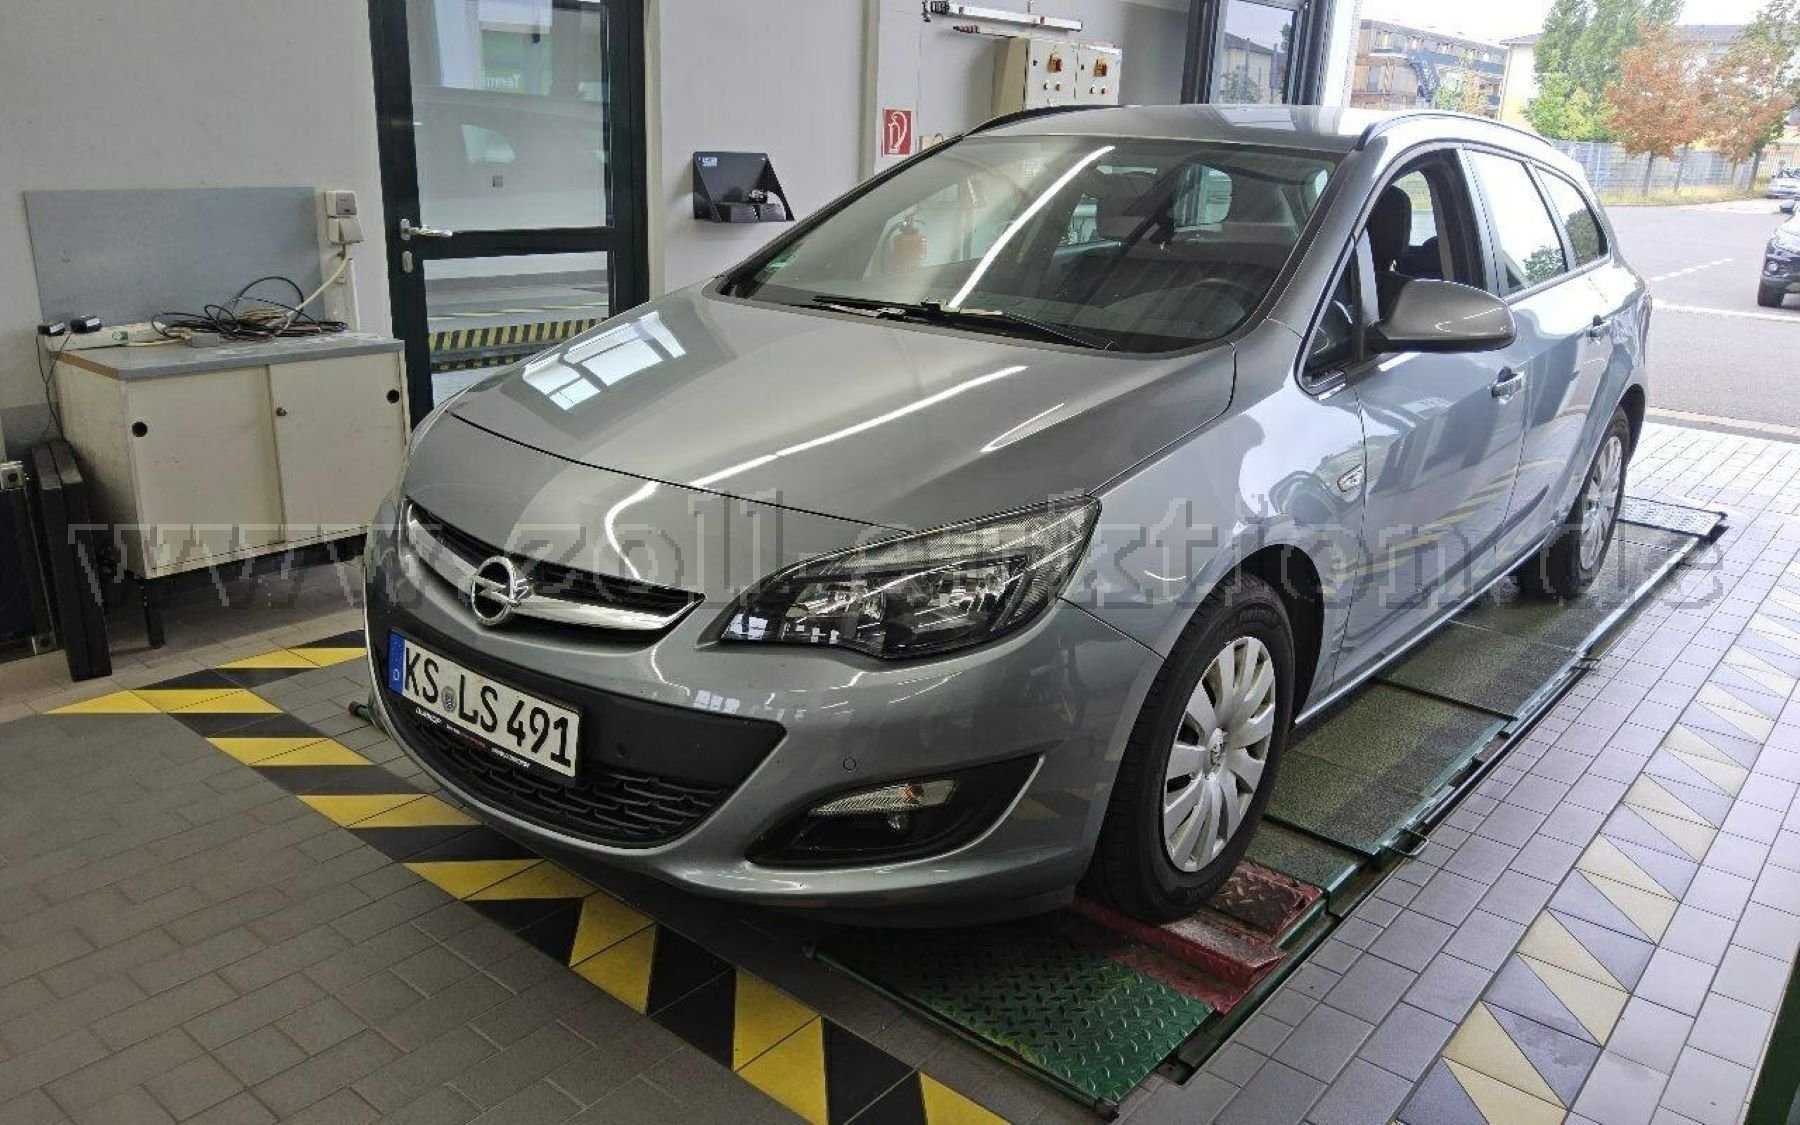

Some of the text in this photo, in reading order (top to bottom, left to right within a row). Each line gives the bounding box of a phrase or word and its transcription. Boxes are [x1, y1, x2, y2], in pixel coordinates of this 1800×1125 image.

[404, 647, 571, 768] KS LS 491
